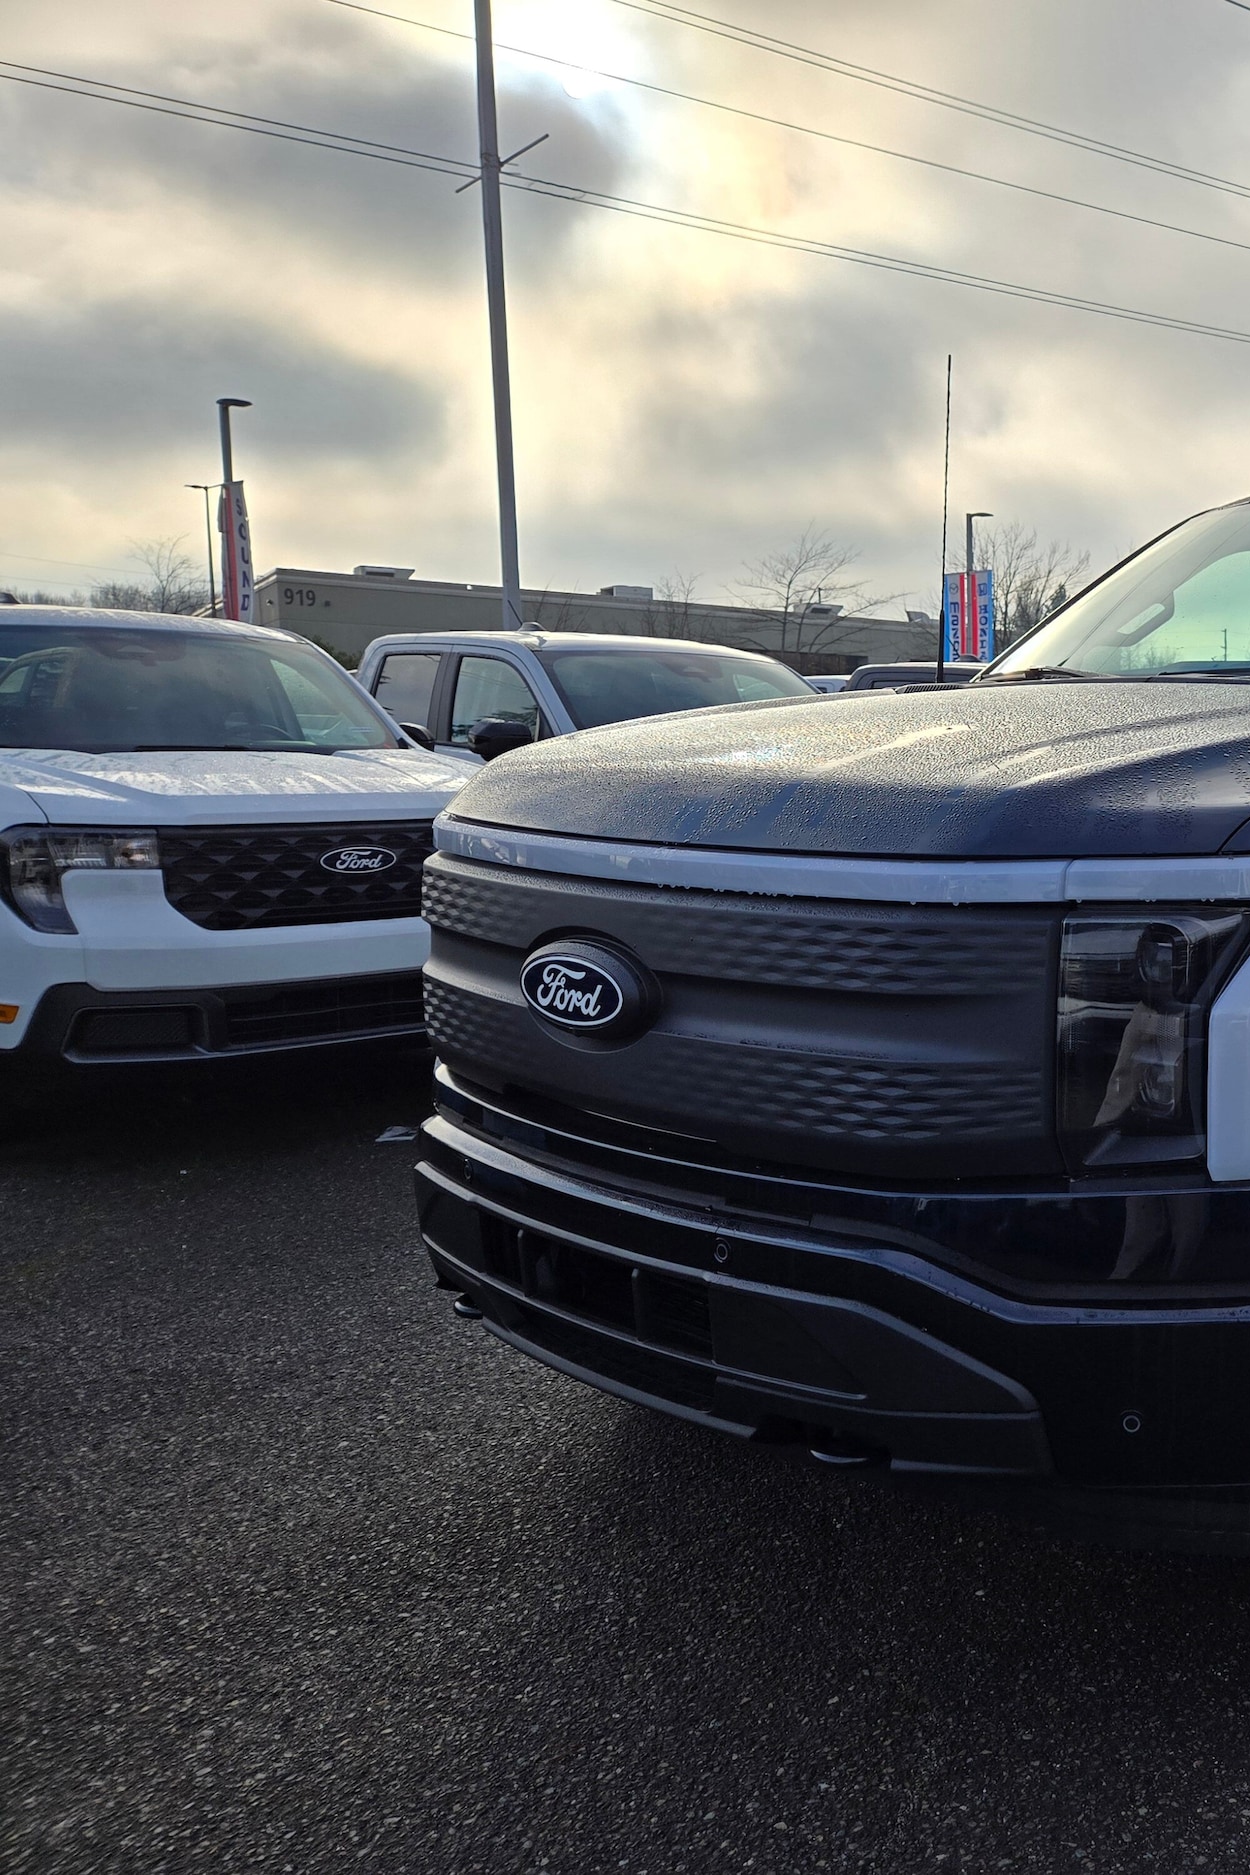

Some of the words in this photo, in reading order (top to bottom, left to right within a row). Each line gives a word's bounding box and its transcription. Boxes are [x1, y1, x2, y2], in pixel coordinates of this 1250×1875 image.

[284, 588, 316, 607] 919
[336, 851, 383, 869] Ford
[537, 963, 602, 1017] Ford
